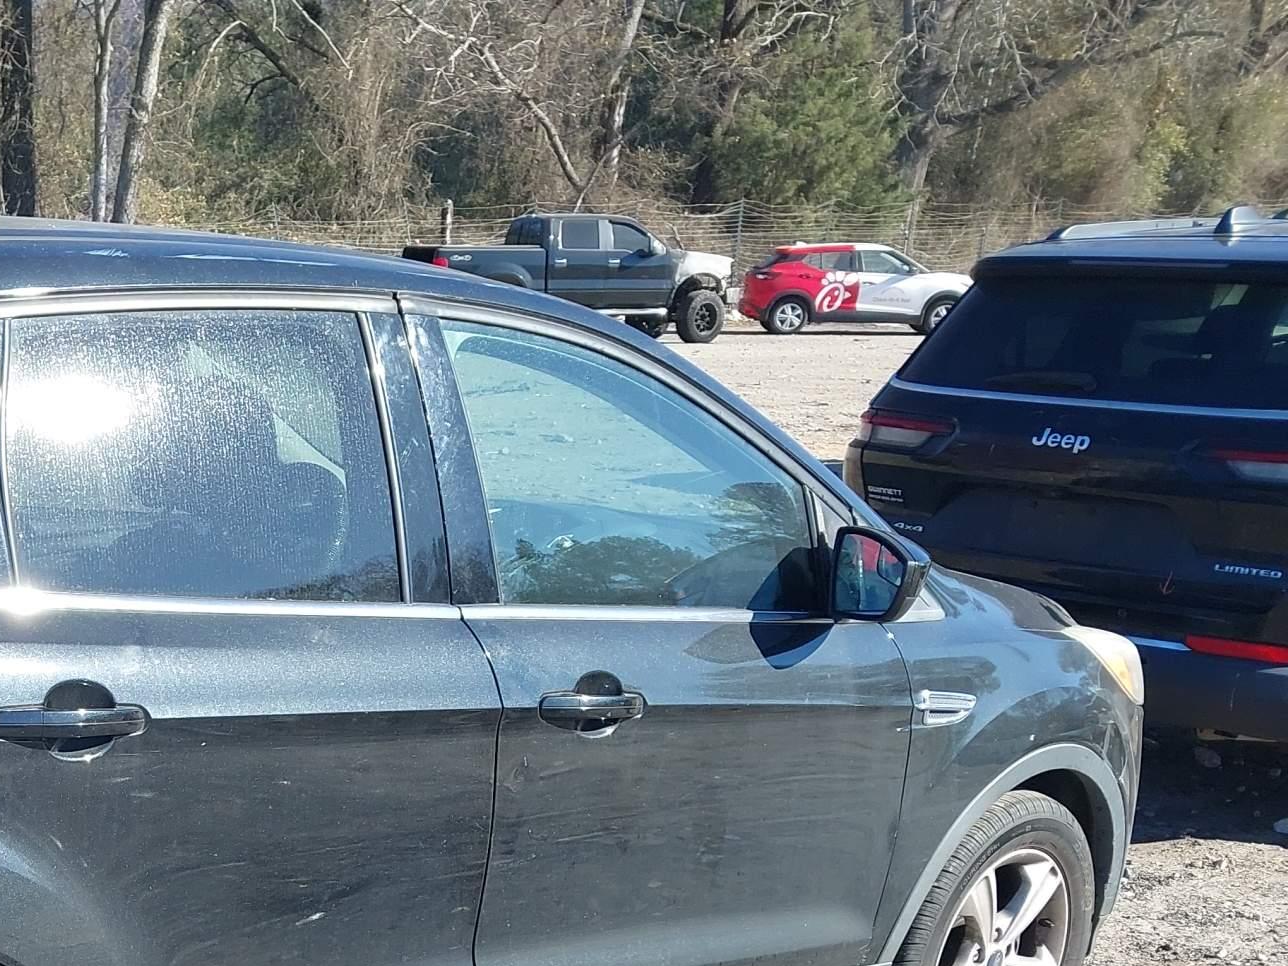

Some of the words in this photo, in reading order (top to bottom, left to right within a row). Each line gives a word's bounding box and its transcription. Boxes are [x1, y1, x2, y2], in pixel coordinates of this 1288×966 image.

[1032, 428, 1090, 453] Jeep
[894, 522, 923, 532] 4x4
[1214, 563, 1283, 578] LIMITED
